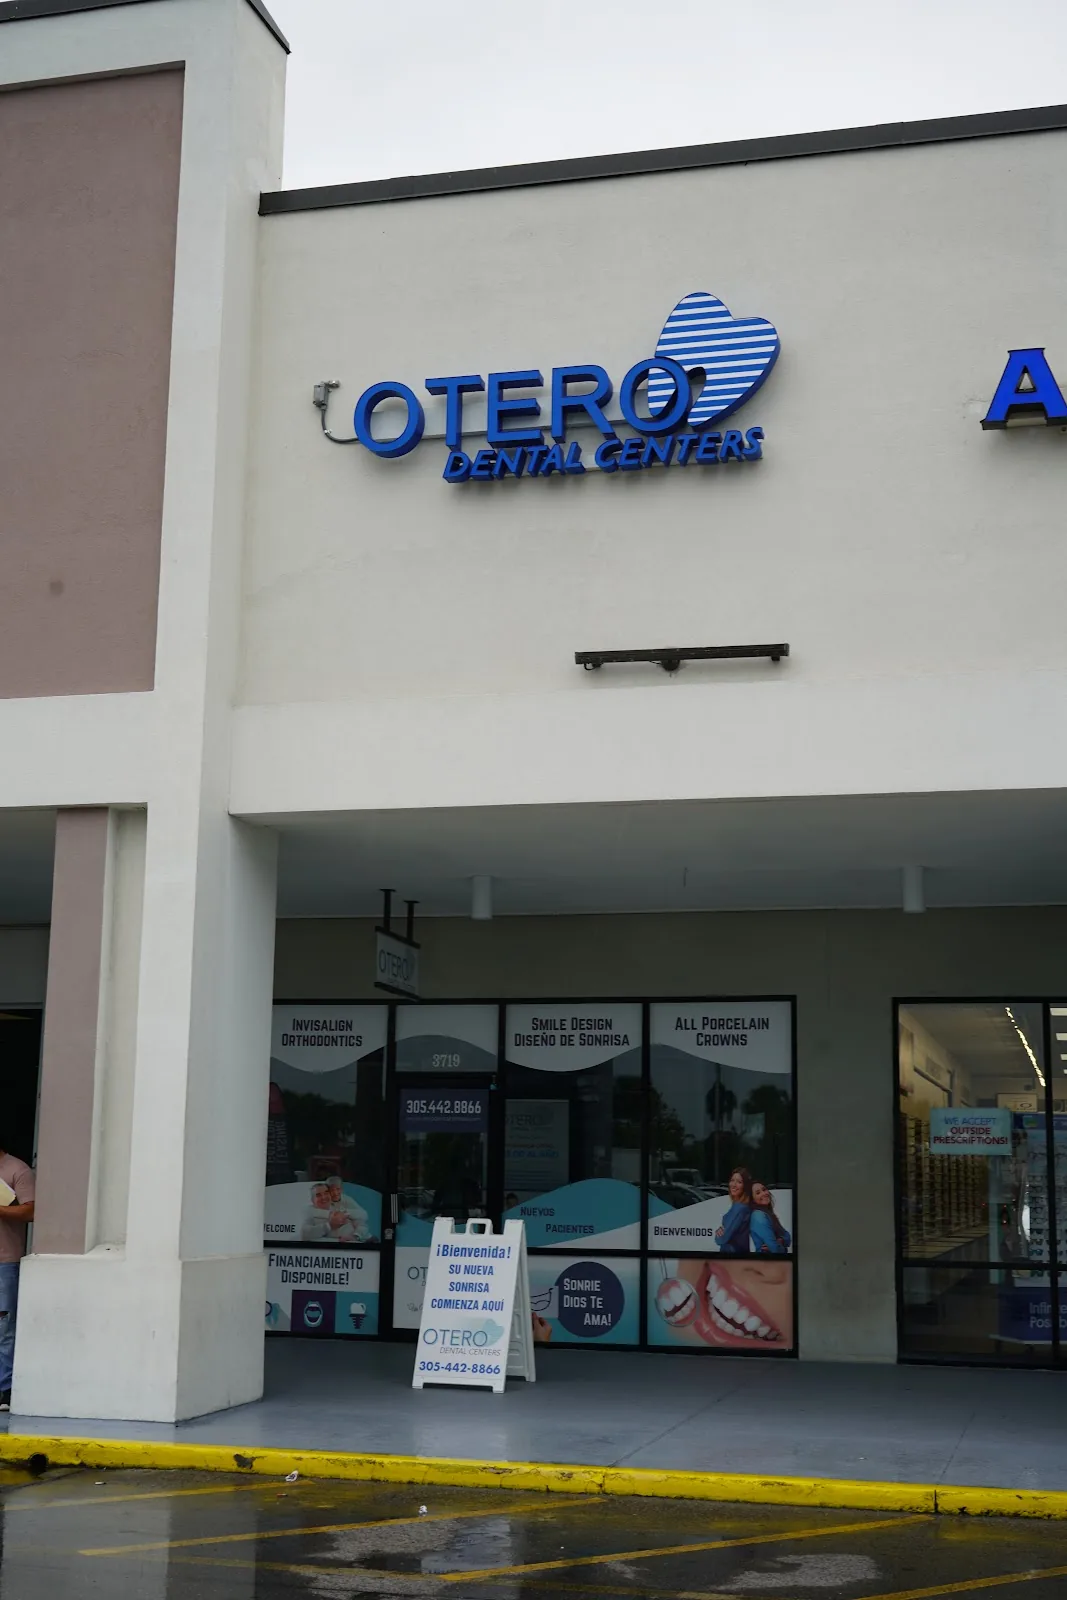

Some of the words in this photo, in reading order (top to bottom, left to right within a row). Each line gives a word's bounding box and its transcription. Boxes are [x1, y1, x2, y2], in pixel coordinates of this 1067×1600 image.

[353, 356, 693, 459] OTERO
[443, 441, 585, 484] DENTAL
[594, 426, 765, 474] CENTERS
[292, 1017, 353, 1032] INVISALIGN
[531, 1017, 567, 1031] SMILE
[571, 1017, 613, 1031] DESIGN
[675, 1017, 698, 1030] ALL
[702, 1016, 769, 1030] PORCELAIN
[281, 1033, 363, 1047] ORTHODONTICS
[514, 1031, 556, 1047] DISEÑO
[560, 1033, 575, 1047] DE
[579, 1032, 630, 1047] SONRISA
[696, 1032, 748, 1047] CROWNS
[432, 1053, 461, 1068] 3719
[406, 1099, 482, 1114] 305.442.8866
[944, 1116, 959, 1125] WE
[961, 1117, 997, 1126] ACCEPT
[950, 1126, 991, 1135] OUTSIDE
[933, 1135, 1008, 1145] PRESCRIPTIONS!
[520, 1206, 555, 1217] NUEVOS
[545, 1223, 594, 1234] PACIENTES
[653, 1226, 713, 1237] BIENVENIDOS
[436, 1244, 511, 1259] ¡Bienvenida!
[268, 1253, 363, 1270] FINANCIAMIENTO
[448, 1264, 461, 1275] SU
[463, 1265, 494, 1276] NUEVA
[281, 1269, 349, 1286] DISPONIBLE!
[563, 1277, 601, 1292] SONRIE
[448, 1281, 490, 1293] SONRISA
[431, 1298, 479, 1311] COMIENZA
[481, 1298, 504, 1312] AQUÍ
[563, 1294, 587, 1308] DIOS
[590, 1294, 603, 1309] TE
[583, 1312, 612, 1326] AMA!
[422, 1328, 488, 1347] OTERO
[439, 1347, 467, 1355] DENTAL
[468, 1347, 501, 1357] CENTERS
[418, 1361, 501, 1375] 305-442-8866
